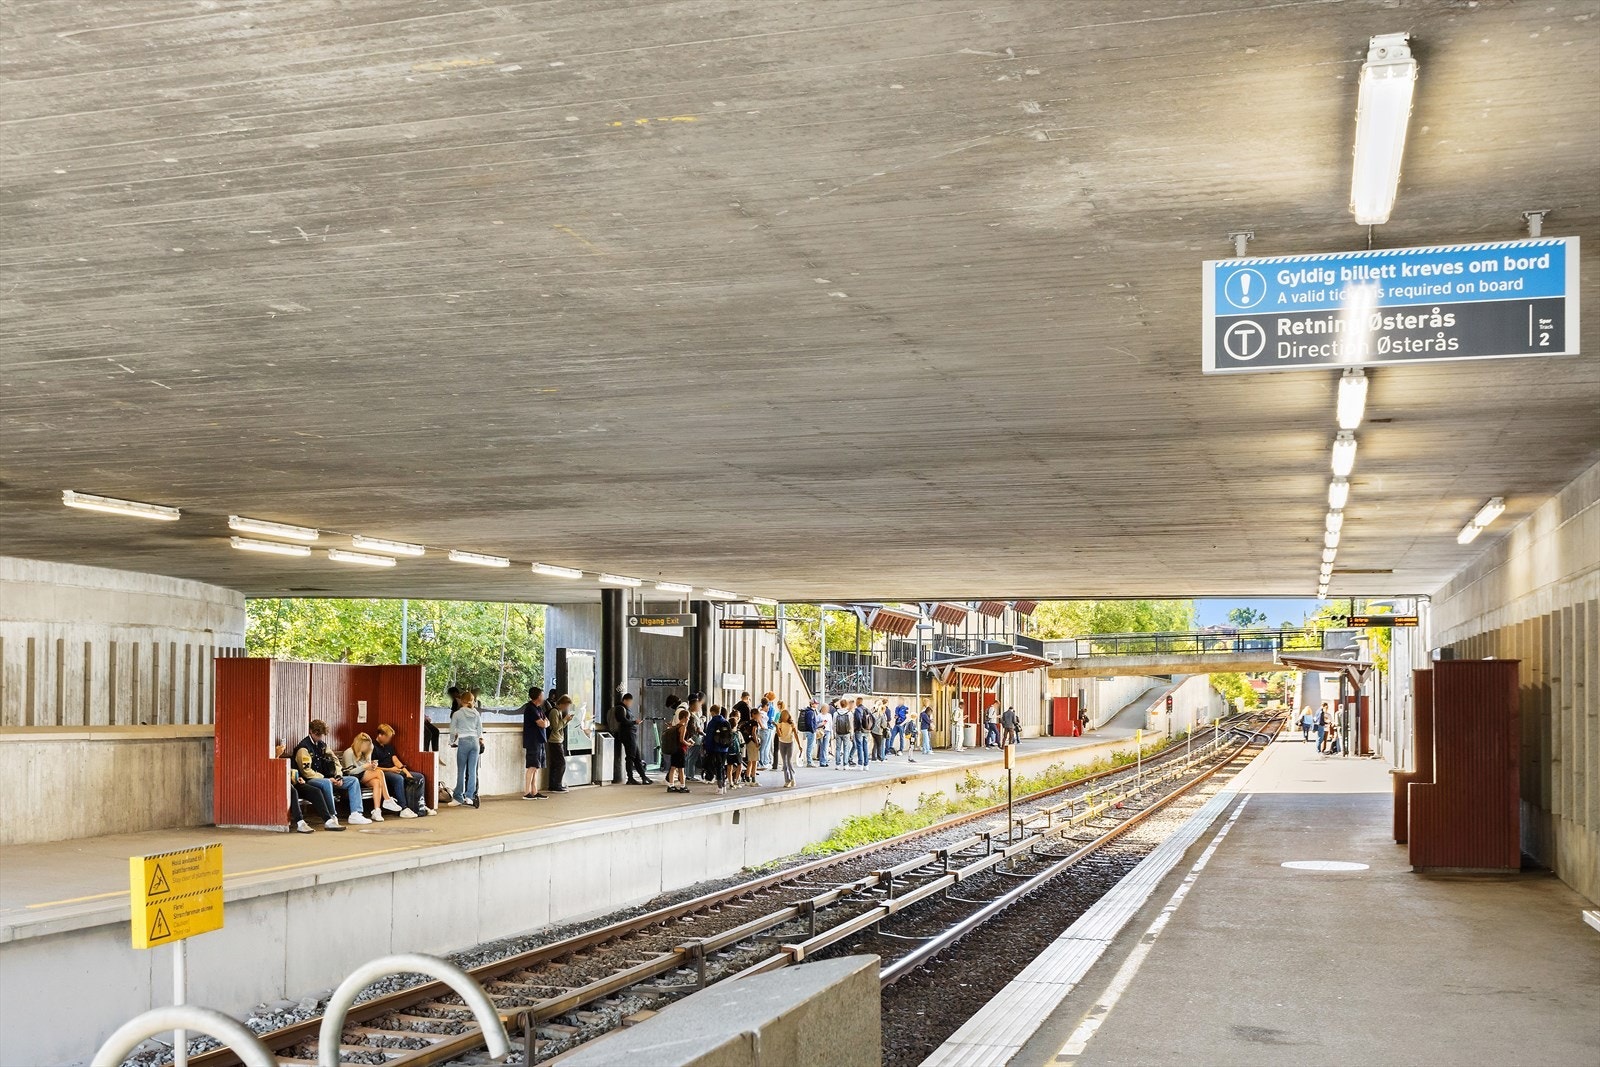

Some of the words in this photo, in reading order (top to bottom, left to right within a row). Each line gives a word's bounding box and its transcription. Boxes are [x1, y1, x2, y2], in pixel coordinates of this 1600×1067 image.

[1277, 267, 1336, 288] Gyldig
[1341, 264, 1397, 281] billett
[1402, 261, 1464, 278] kreves
[1469, 259, 1499, 274] om
[1504, 253, 1550, 271] bord
[1277, 292, 1288, 305] A
[1291, 288, 1325, 303] valid
[1329, 286, 1370, 302] tic
[1389, 282, 1451, 299] required
[1456, 281, 1475, 295] on
[1479, 277, 1524, 292] board
[1369, 307, 1456, 332] Østerås
[1277, 339, 1369, 359] Direction
[1378, 332, 1460, 354] Østerås
[1539, 332, 1550, 346] 2
[640, 617, 665, 626] Utgang
[666, 616, 680, 625] Exit
